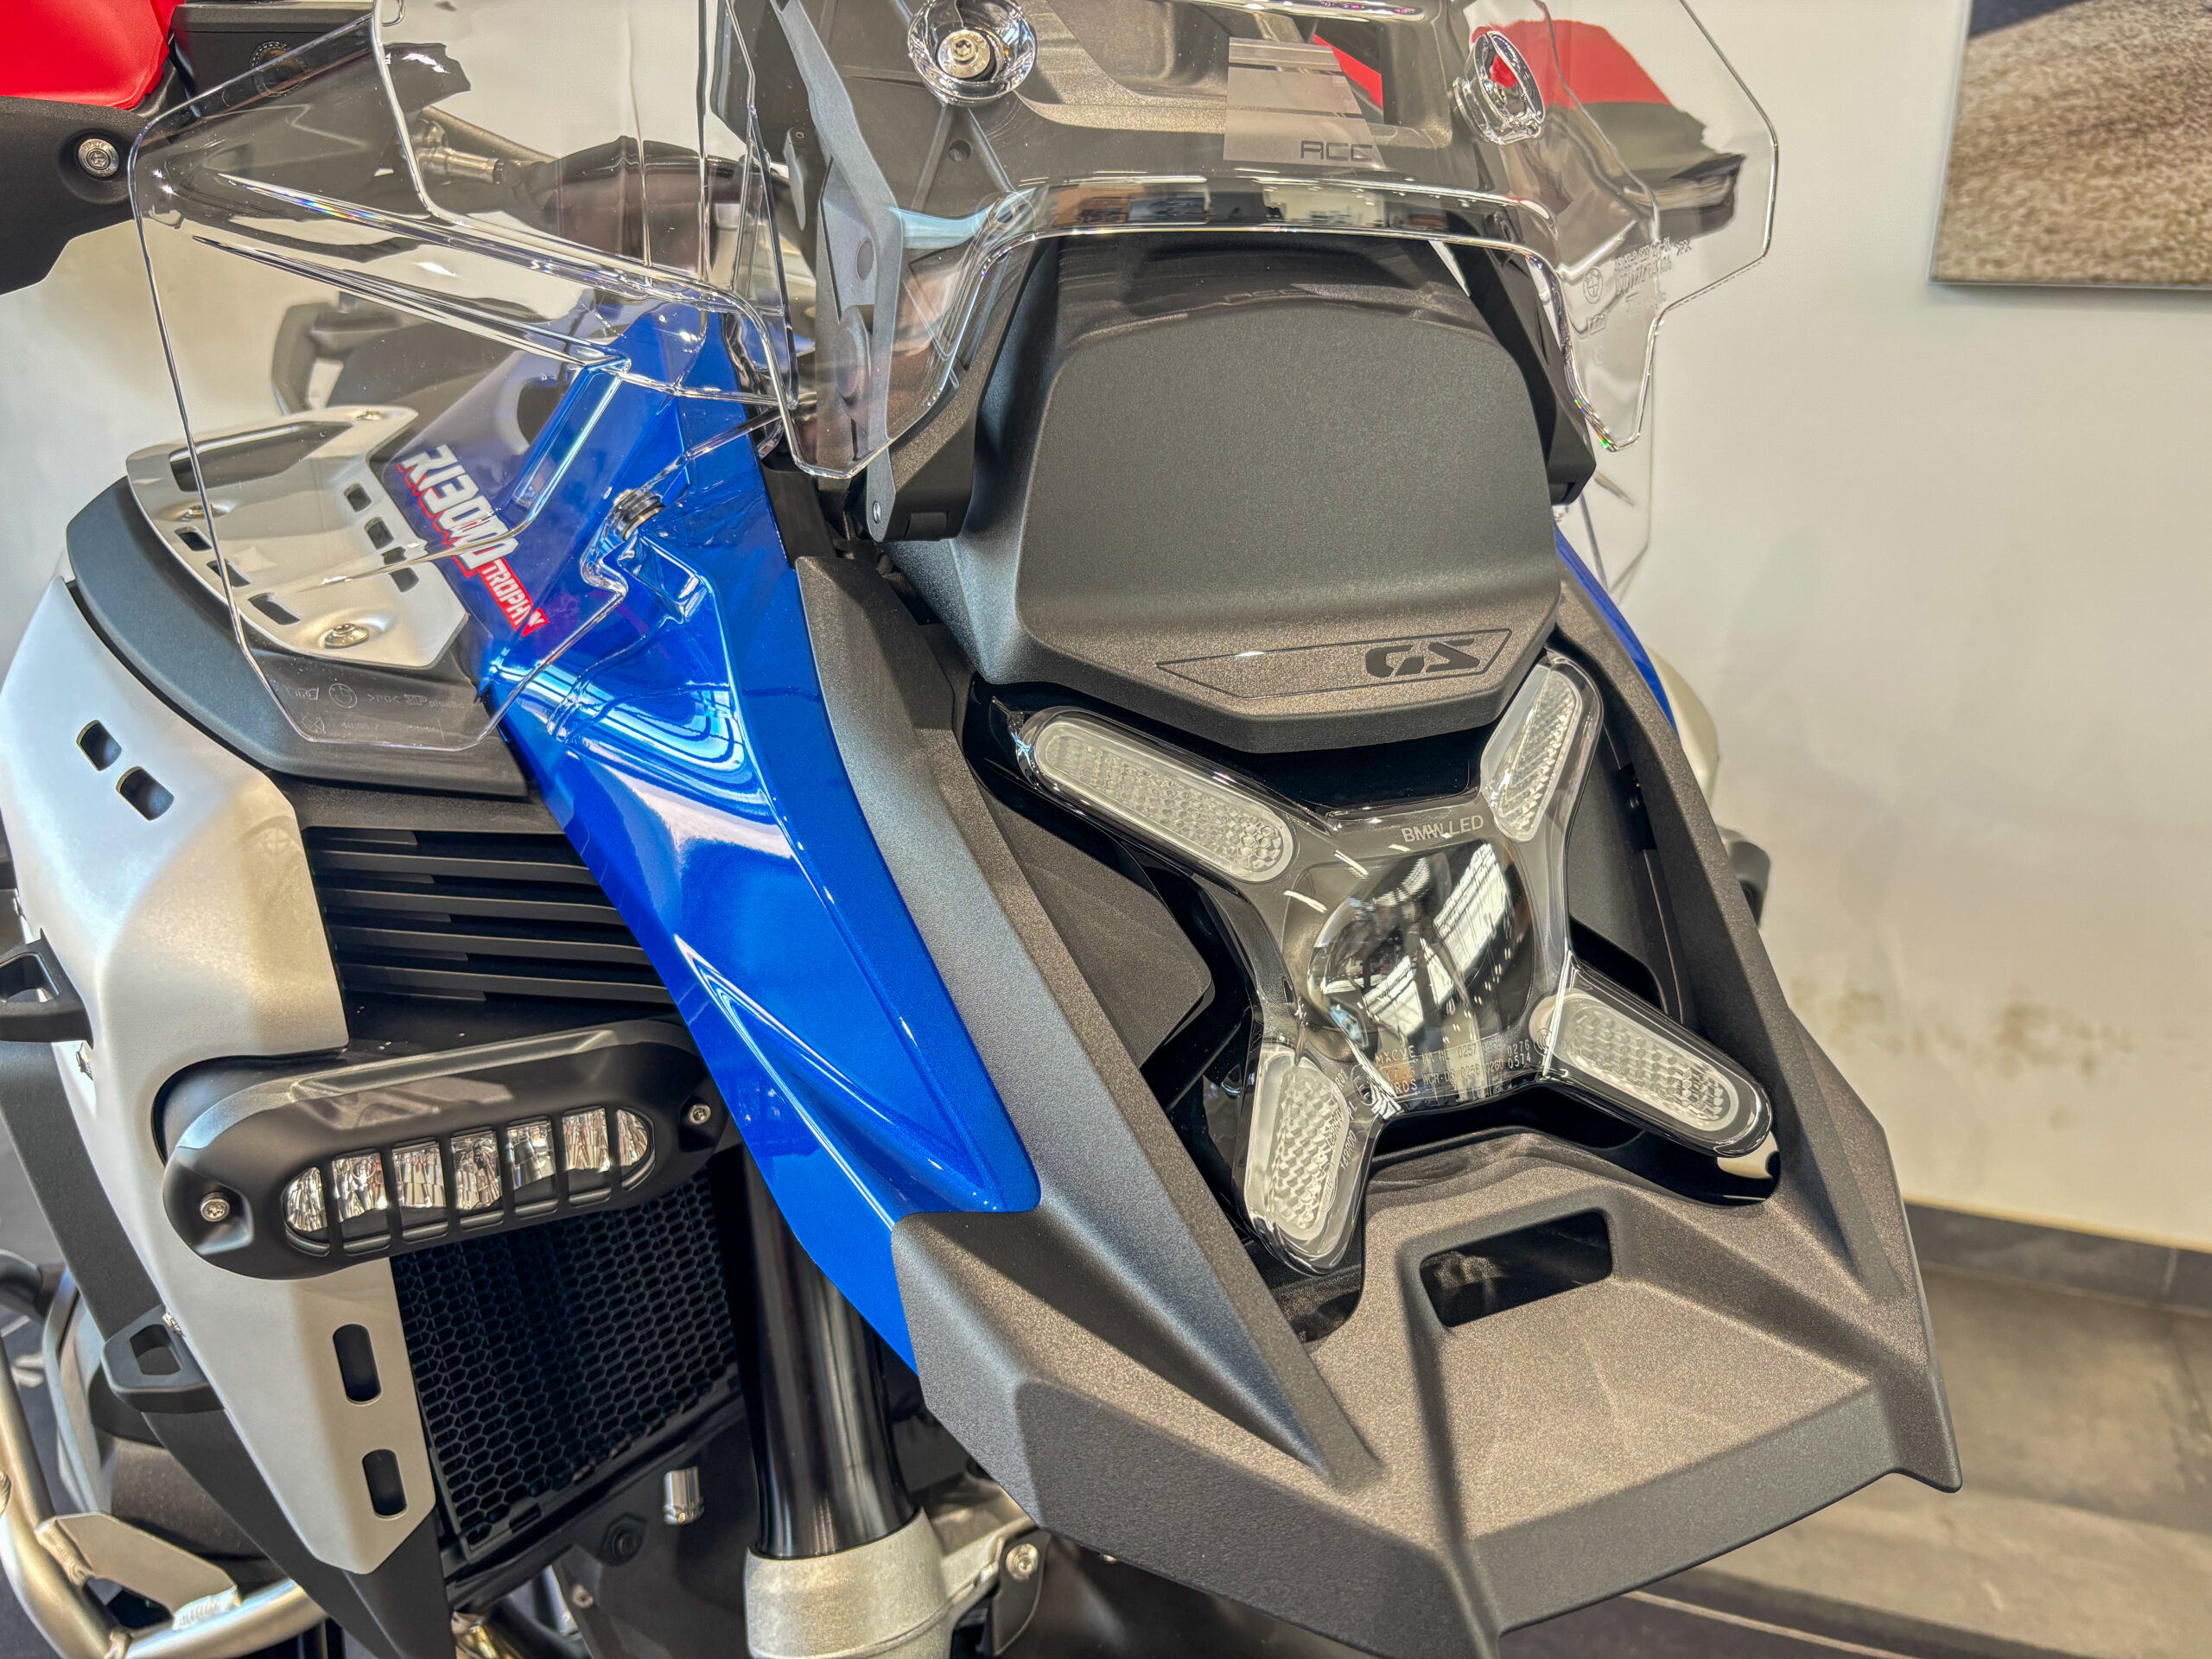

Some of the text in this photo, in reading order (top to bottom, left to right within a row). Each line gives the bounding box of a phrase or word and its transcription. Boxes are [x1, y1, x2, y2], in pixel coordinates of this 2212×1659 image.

[1300, 140, 1373, 162] ACC
[482, 561, 546, 626] TROPHY
[1365, 638, 1481, 678] GS
[1401, 815, 1484, 843] BMW LED
[1375, 1045, 1416, 1065] MXCVE
[1457, 1042, 1478, 1058] 0257
[1506, 1039, 1530, 1057] 0276
[1484, 1058, 1504, 1073] 0260
[1507, 1052, 1531, 1069] 0574
